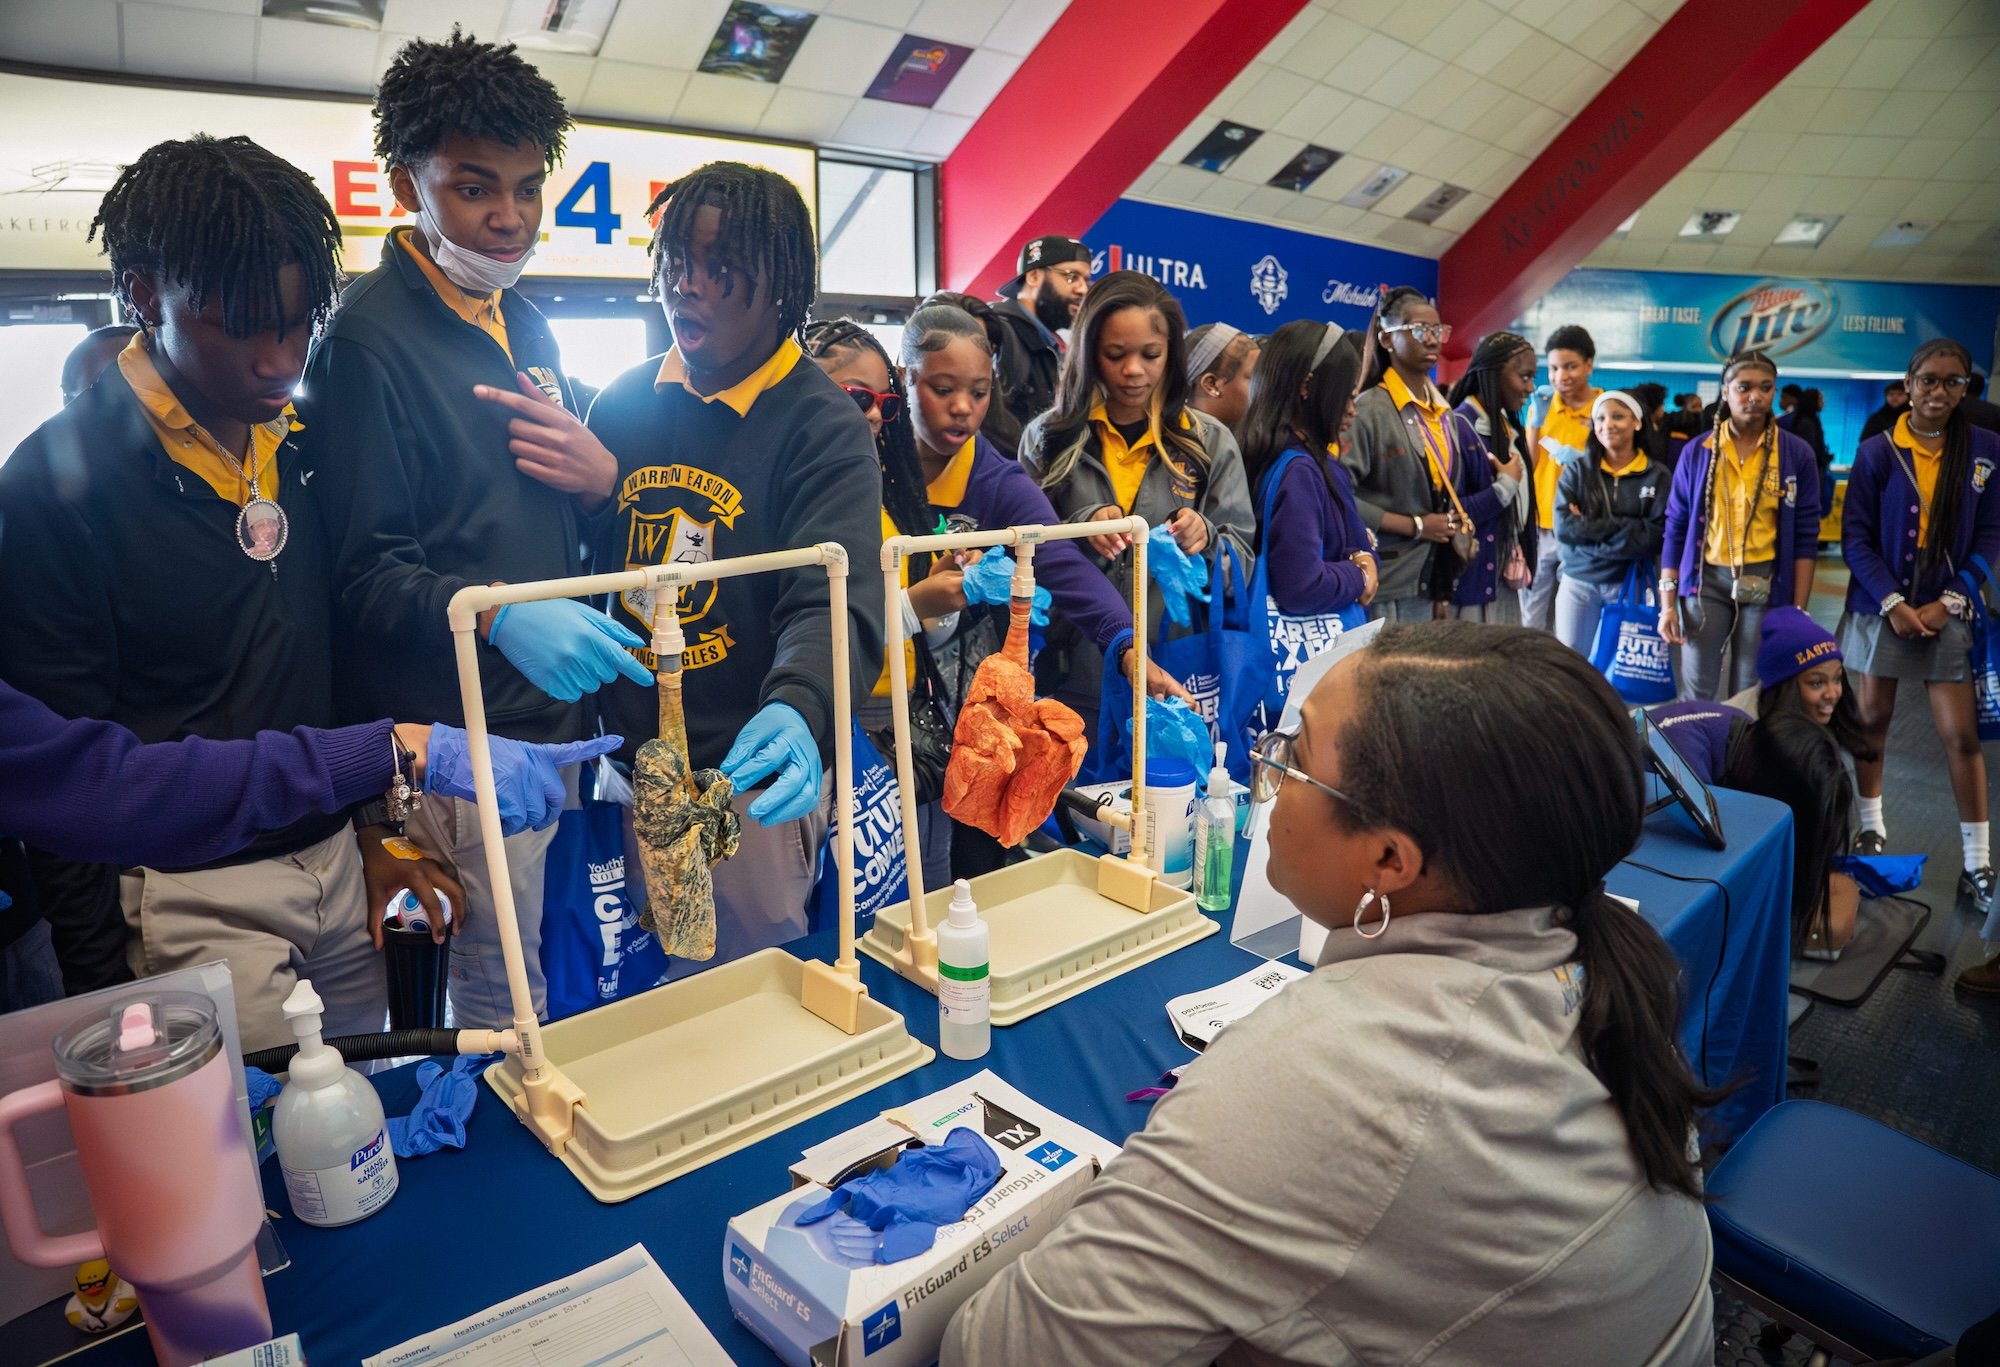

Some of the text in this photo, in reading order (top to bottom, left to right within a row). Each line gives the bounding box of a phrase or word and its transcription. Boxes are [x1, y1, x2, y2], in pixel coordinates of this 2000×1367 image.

[555, 161, 622, 245] 4
[1640, 305, 1669, 323] GREAT
[1751, 289, 1806, 313] Miller
[1731, 302, 1822, 360] Lite
[1843, 315, 1867, 332] LESS
[638, 523, 668, 560] W
[681, 644, 719, 667] GLES
[957, 1102, 977, 1115] 230
[994, 1123, 1035, 1145] XL
[355, 1134, 384, 1165] Purell
[357, 1158, 389, 1185] SANITIZER
[363, 1157, 384, 1174] HAND
[984, 1169, 1046, 1209] FitGuard
[973, 1240, 992, 1264] ES
[991, 1214, 1031, 1250] Select
[751, 1278, 779, 1312] Select
[752, 1262, 796, 1307] FitGuard
[796, 1301, 812, 1322] ES
[453, 1285, 571, 1340] Healthy vs. Vaping Lung Script
[392, 1344, 431, 1365] Ochsner
[532, 1337, 550, 1348] Notes
